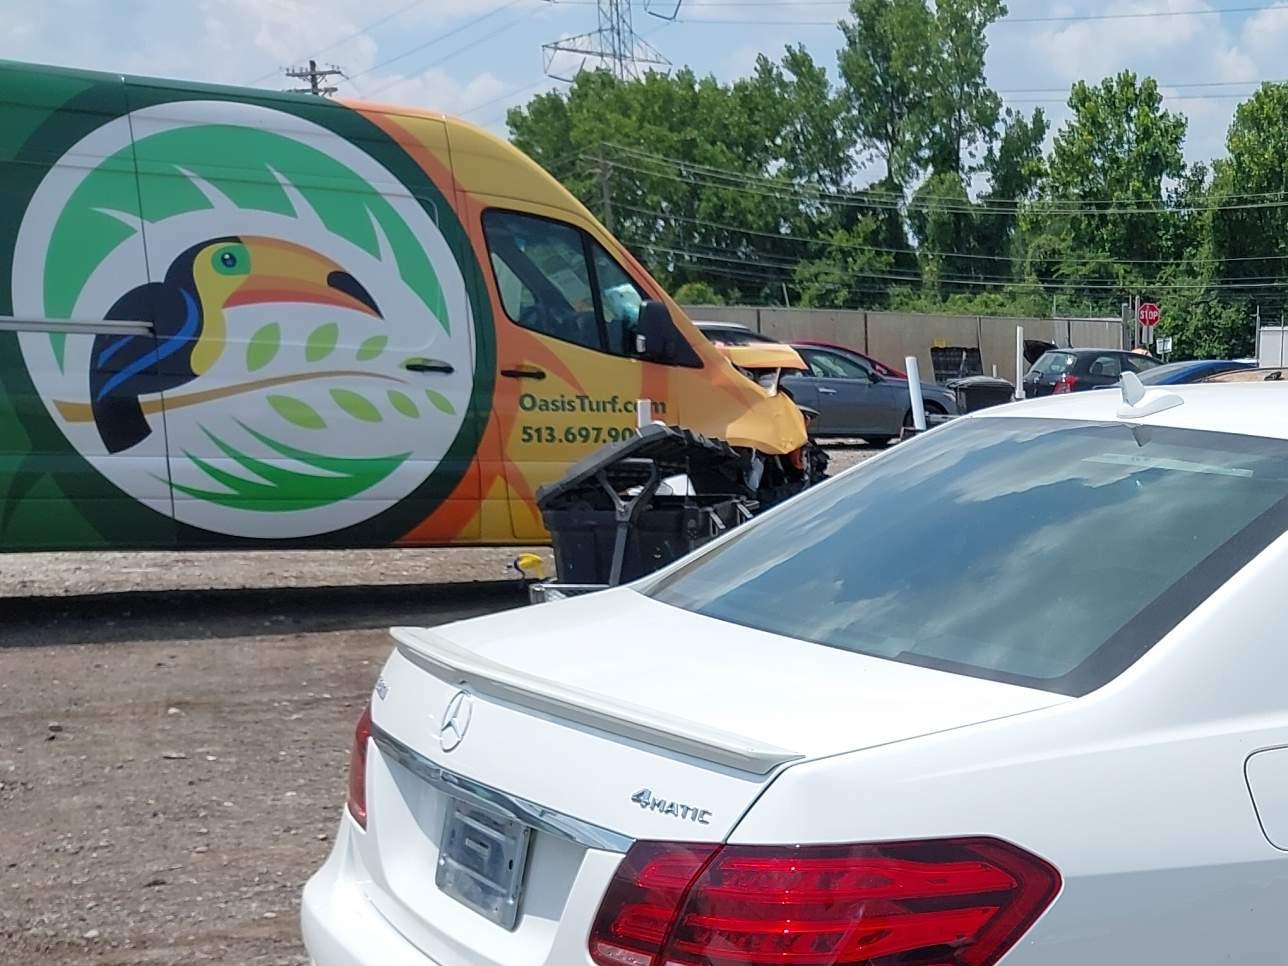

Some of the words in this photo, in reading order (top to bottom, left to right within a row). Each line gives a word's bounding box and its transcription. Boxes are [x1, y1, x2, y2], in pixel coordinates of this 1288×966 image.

[1140, 310, 1158, 320] STOP
[519, 394, 667, 414] OasisTurf.cm
[521, 426, 638, 443] 513.697.90
[631, 788, 713, 825] 4MATIC
